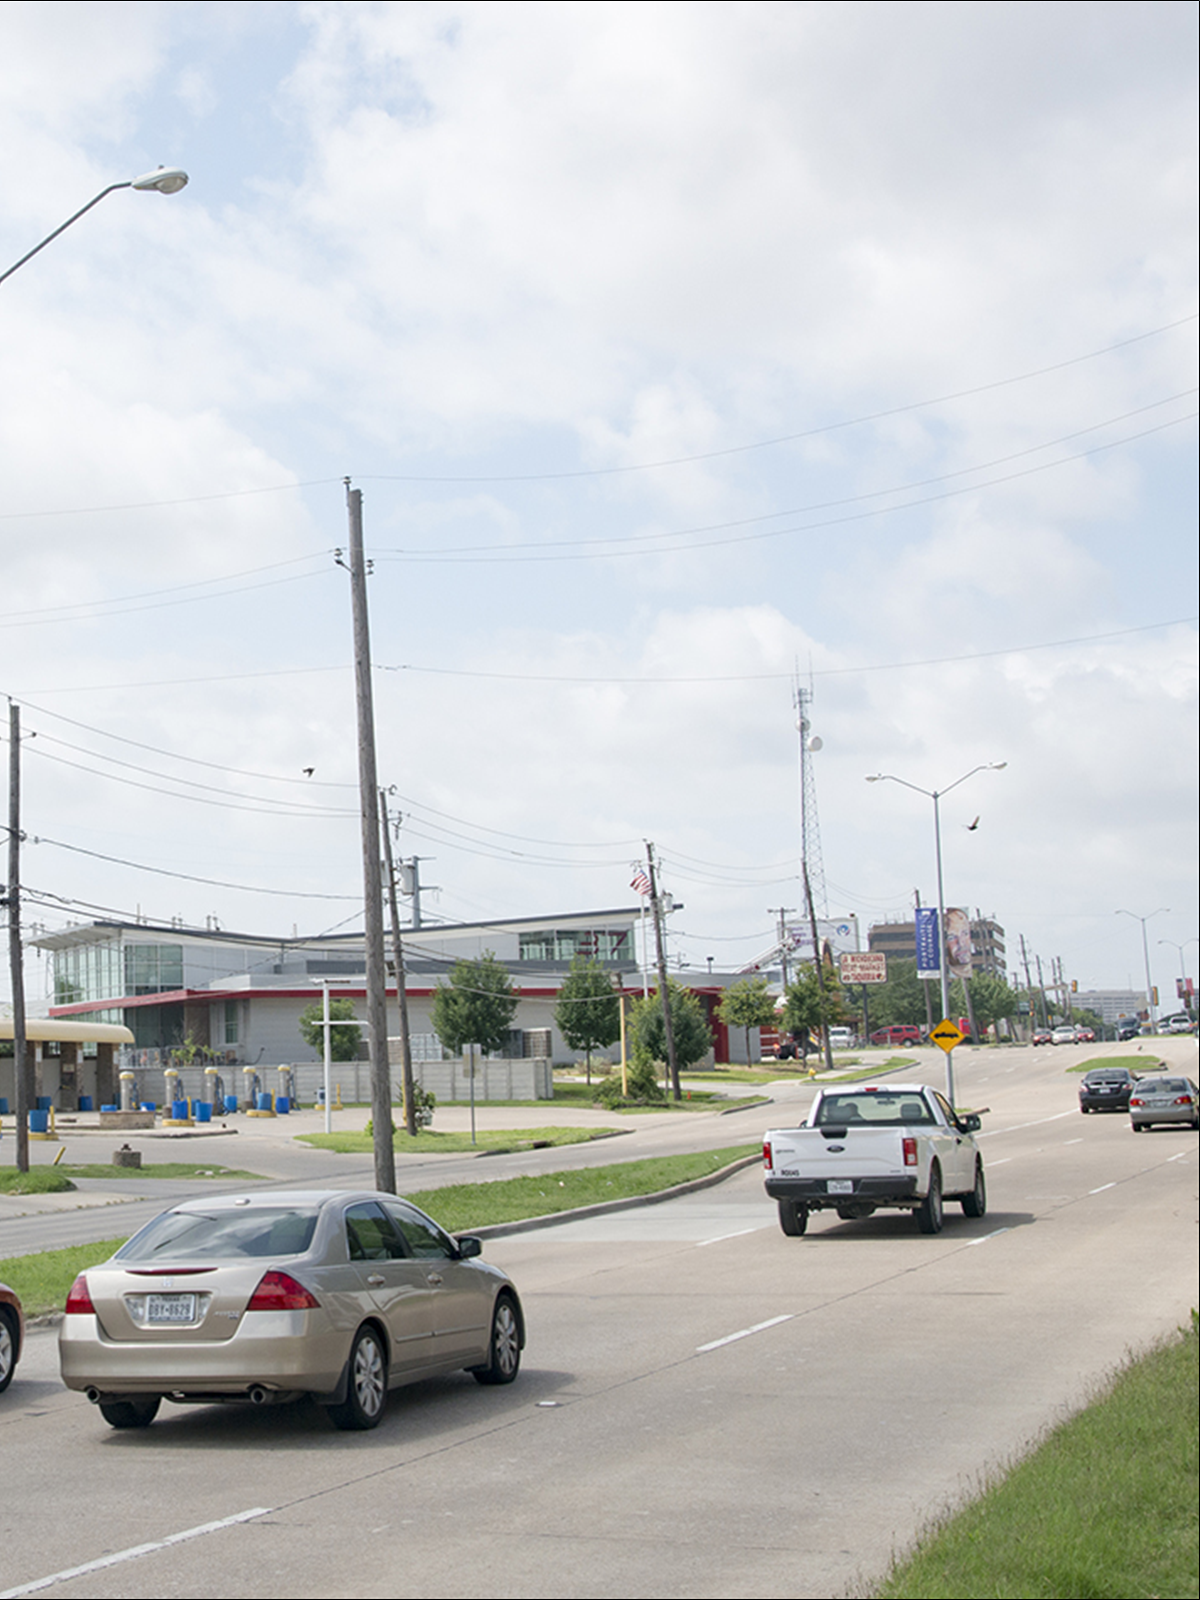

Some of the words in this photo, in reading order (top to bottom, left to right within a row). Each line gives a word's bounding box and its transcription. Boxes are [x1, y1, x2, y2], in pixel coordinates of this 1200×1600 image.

[577, 931, 627, 955] 37
[920, 924, 928, 967] PORTRAITS
[927, 925, 935, 958] COURAGE
